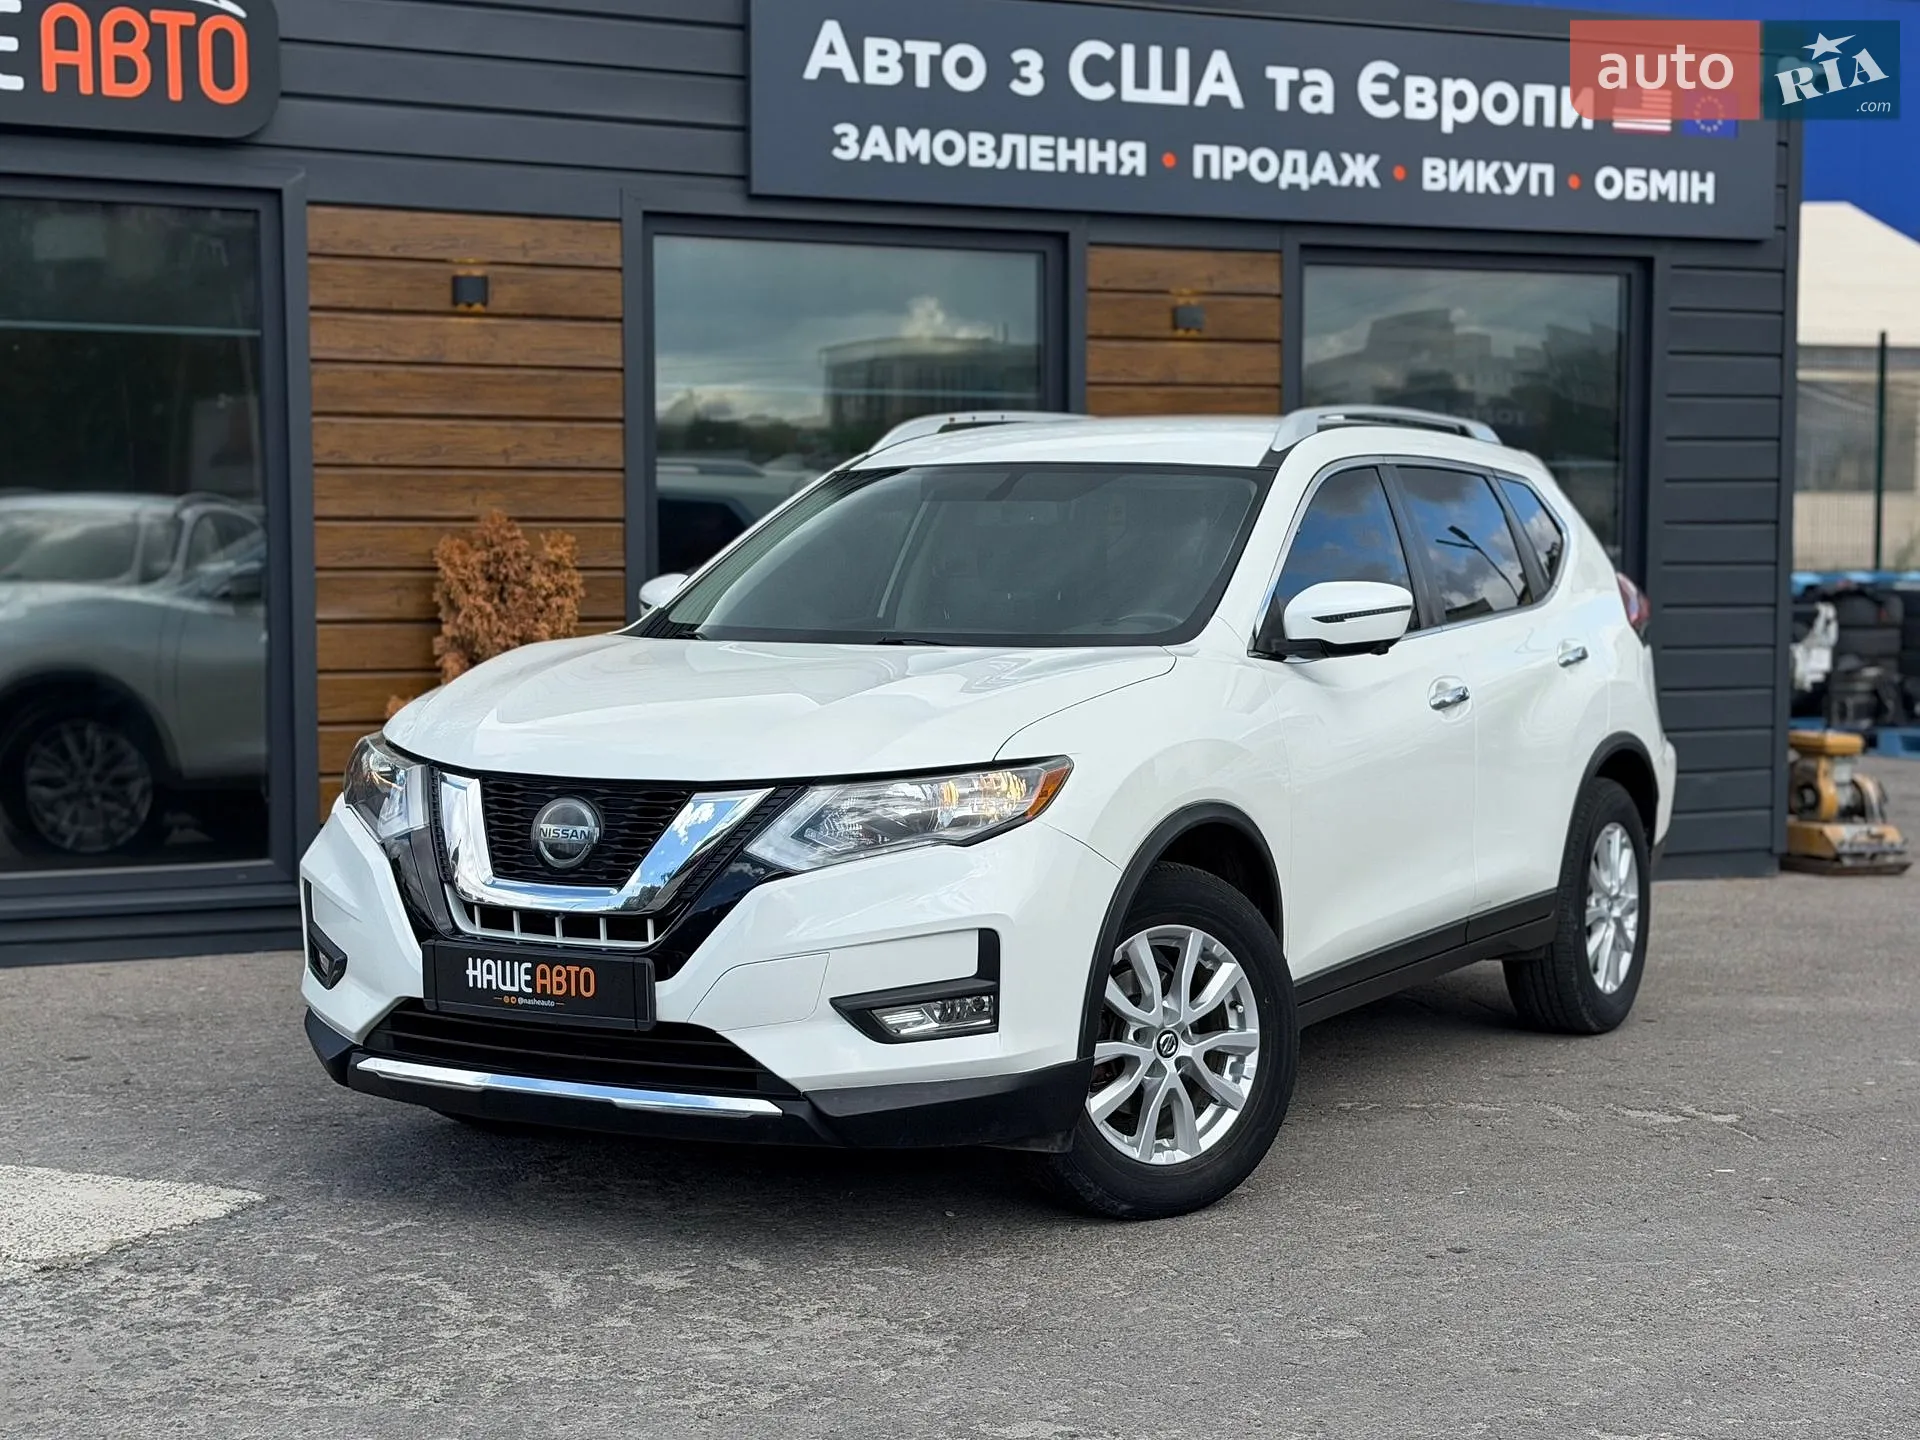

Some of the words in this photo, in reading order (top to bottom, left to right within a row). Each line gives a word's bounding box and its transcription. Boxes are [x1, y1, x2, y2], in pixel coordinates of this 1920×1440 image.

[40, 1, 250, 105] АВТО
[803, 19, 987, 92] Авто
[1009, 48, 1045, 96] з
[1068, 40, 1244, 109] США
[1265, 65, 1335, 115] та
[1357, 60, 1594, 134] Європи
[832, 122, 1147, 177] ЗАМОВЛЕННЯ
[1193, 144, 1381, 191] ПРОДАЖ
[1422, 157, 1555, 197] ВИКУП
[1594, 166, 1715, 204] ОБМІН
[540, 827, 590, 840] NISSAN
[518, 997, 555, 1007] @nasheauto
